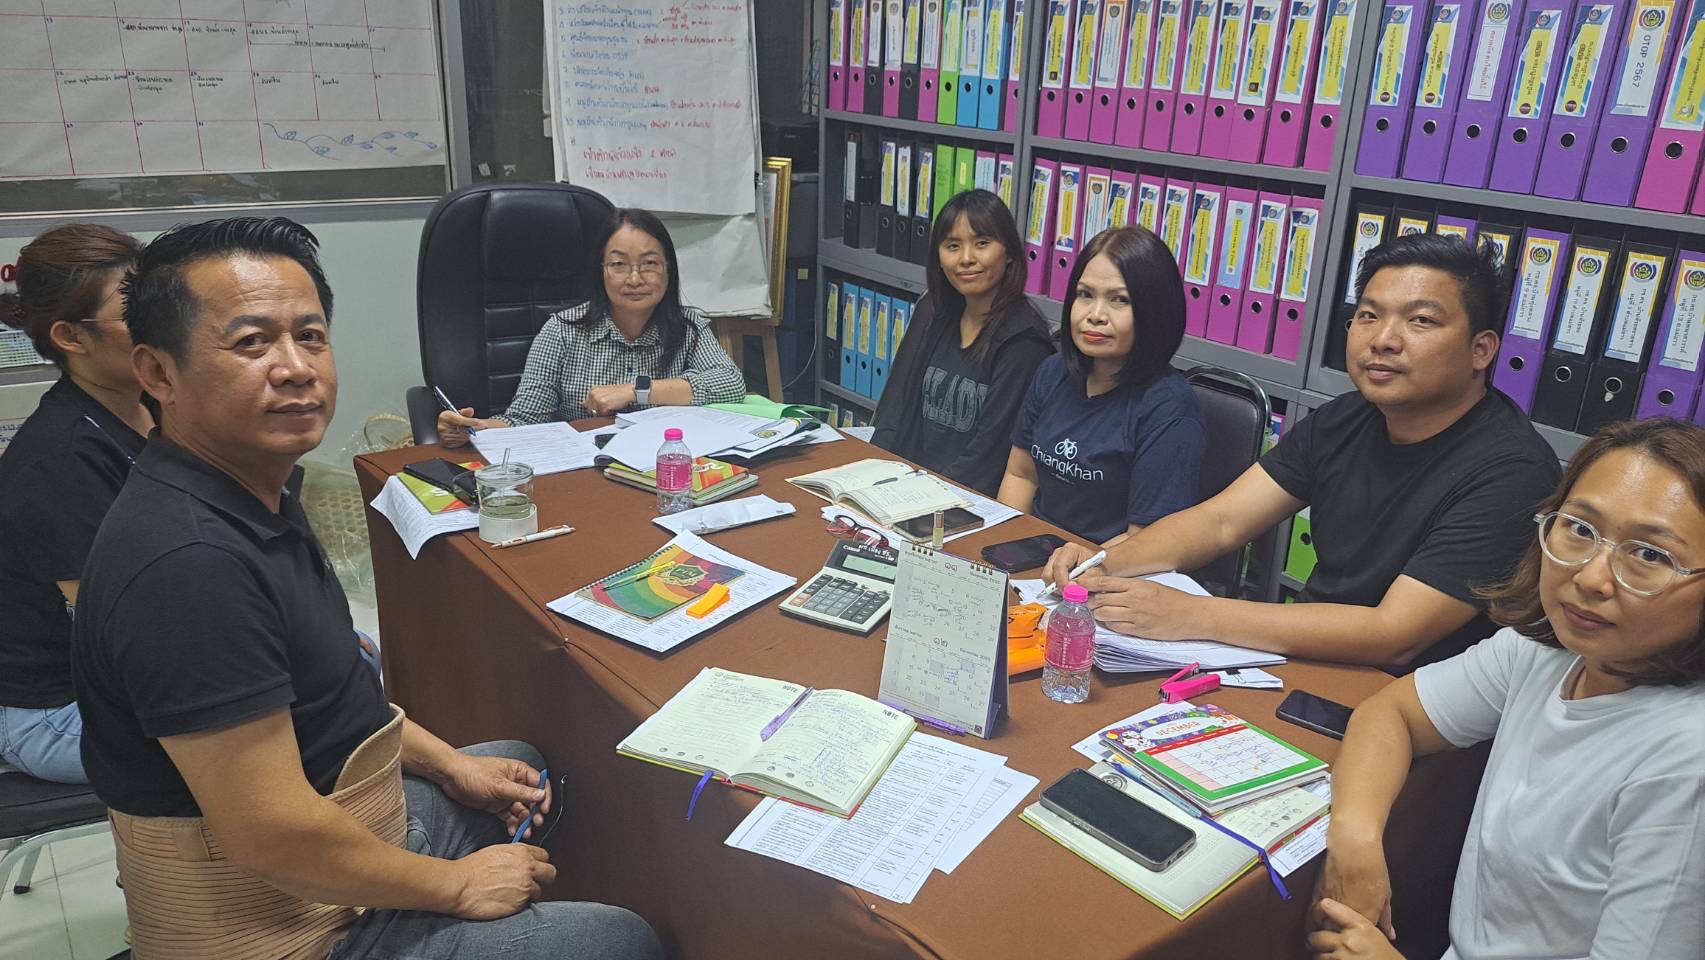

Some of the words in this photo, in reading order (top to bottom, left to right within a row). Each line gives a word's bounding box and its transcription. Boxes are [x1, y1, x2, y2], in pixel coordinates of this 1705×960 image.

[1640, 35, 1651, 58] OTOP
[1632, 62, 1644, 88] 2567
[1031, 444, 1103, 481] ChiangKhan
[782, 685, 798, 693] NOTE
[882, 709, 900, 720] NOTE
[1155, 720, 1201, 736] DECEMBER
